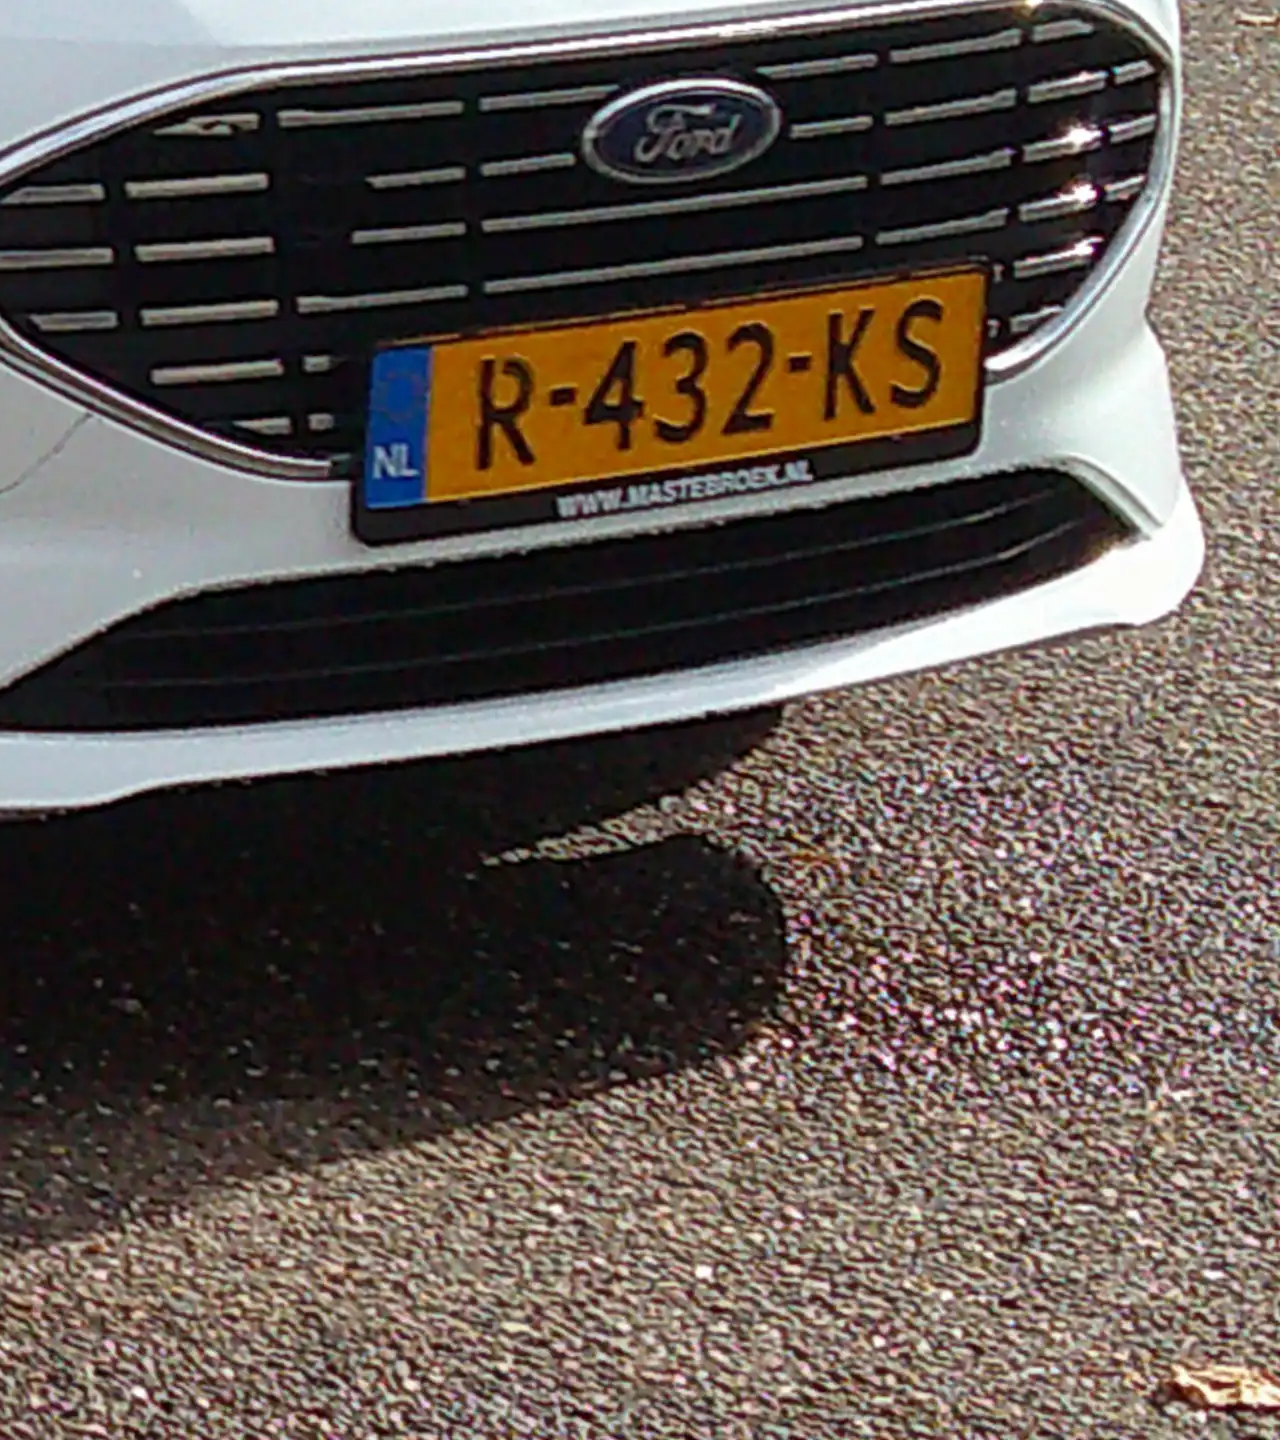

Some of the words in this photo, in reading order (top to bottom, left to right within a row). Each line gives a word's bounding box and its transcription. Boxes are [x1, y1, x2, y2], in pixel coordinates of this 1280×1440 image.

[635, 102, 743, 163] Ford
[475, 298, 945, 471] R-432-KS
[372, 444, 420, 479] NL
